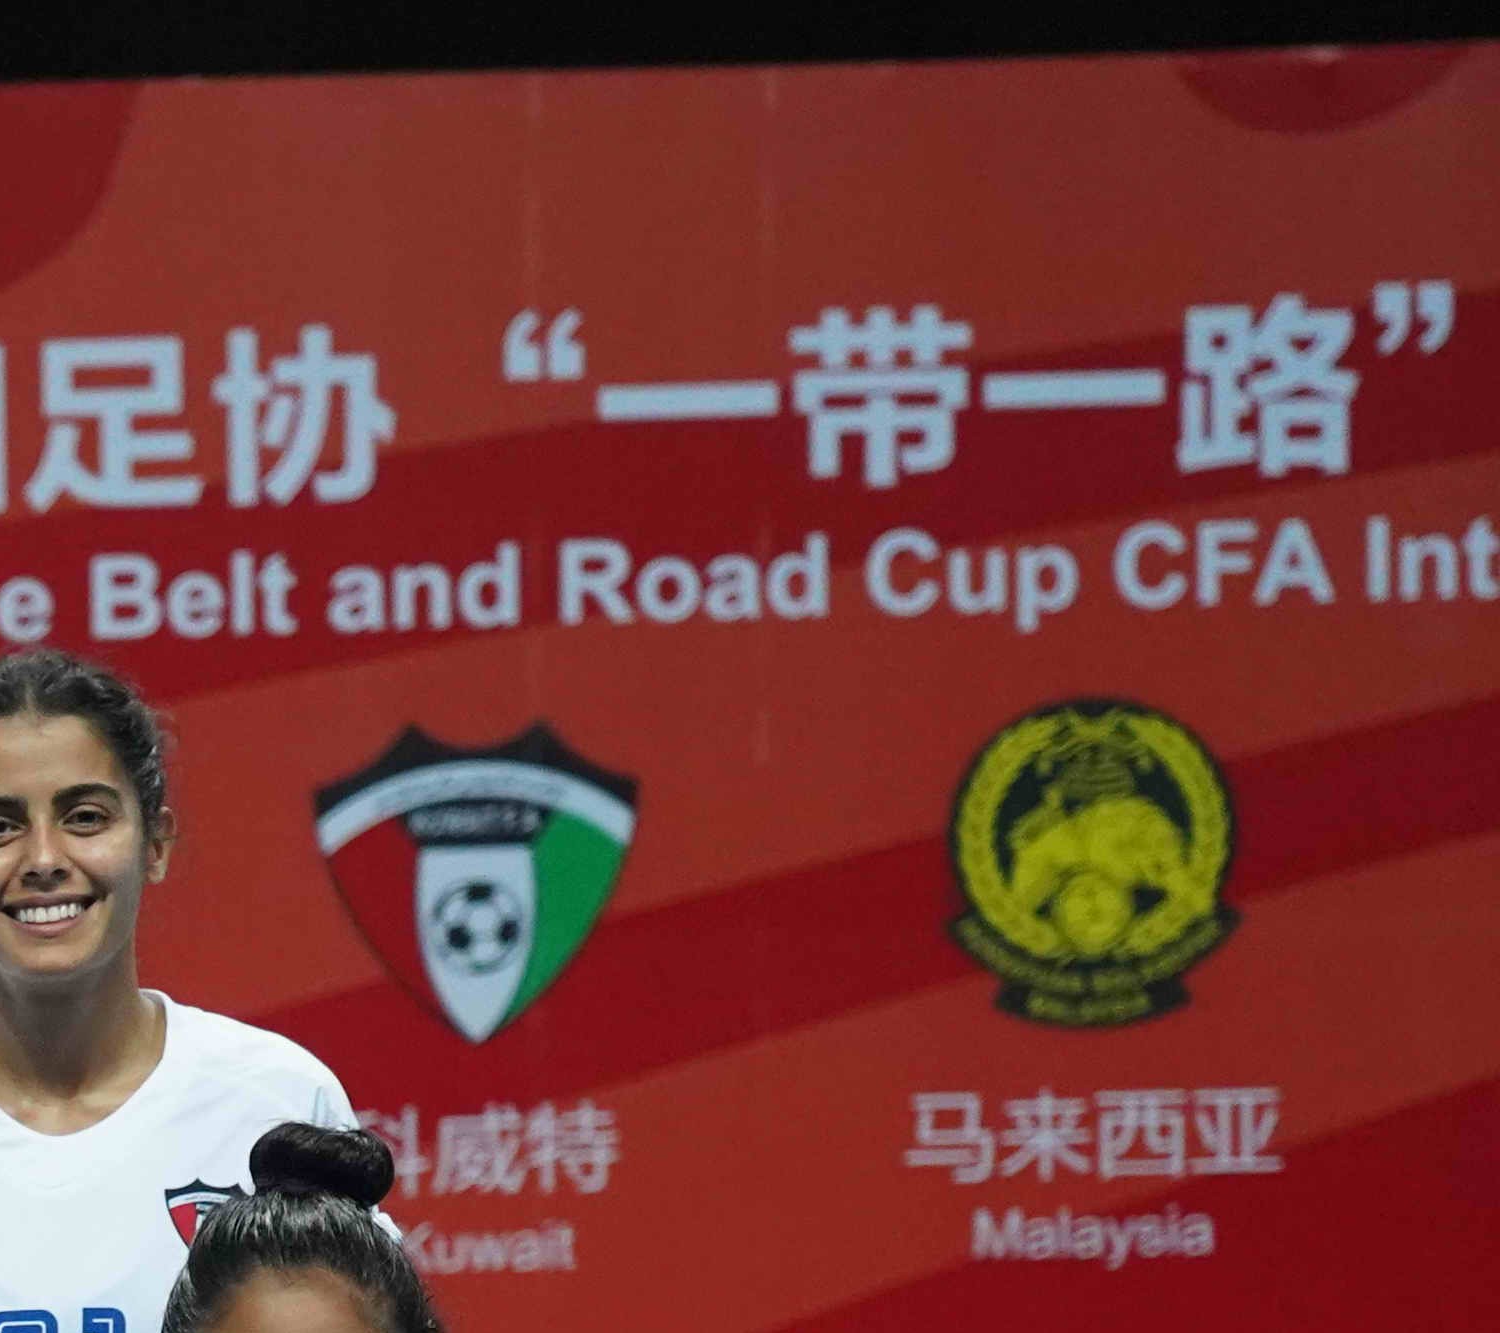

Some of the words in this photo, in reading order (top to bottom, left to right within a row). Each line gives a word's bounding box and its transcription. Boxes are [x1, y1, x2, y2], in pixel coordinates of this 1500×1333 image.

[503, 280, 1456, 490] “一带一路”
[88, 548, 299, 641] Belt
[326, 540, 523, 632] and
[558, 529, 831, 626] Road
[864, 526, 1080, 634] Cup
[1112, 518, 1336, 610] CFA
[904, 1086, 1286, 1186] 马来西亚
[403, 1218, 578, 1274] Kuwait
[969, 1204, 1215, 1271] Malaysia
